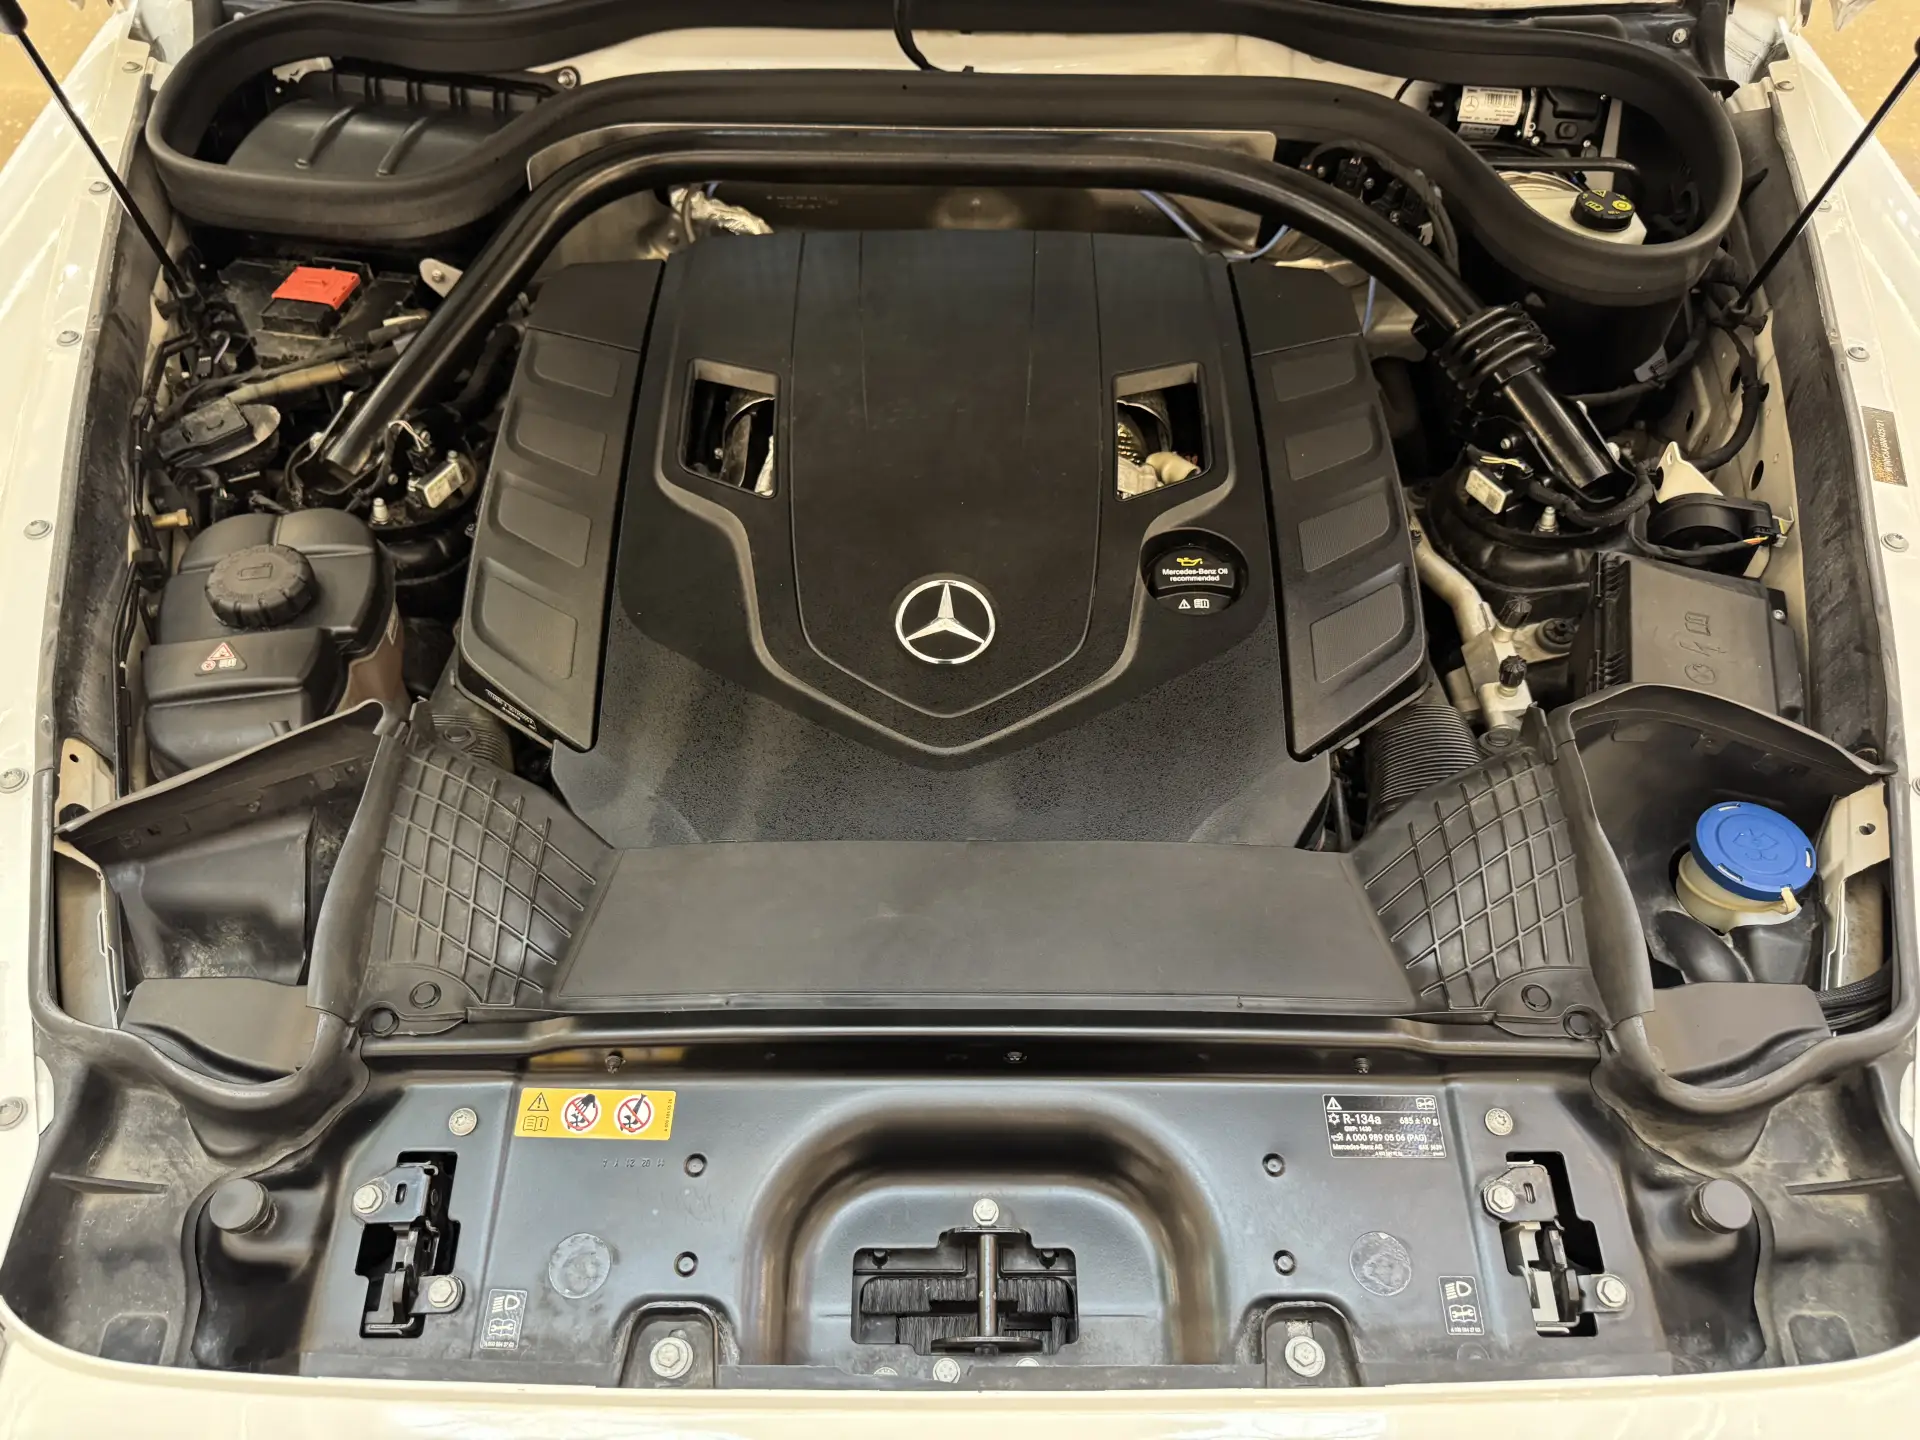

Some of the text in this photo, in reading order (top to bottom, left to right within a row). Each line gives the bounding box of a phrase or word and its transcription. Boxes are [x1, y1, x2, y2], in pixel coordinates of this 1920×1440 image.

[1217, 567, 1228, 575] Oil
[1342, 1113, 1382, 1125] R-134a
[1345, 1133, 1352, 1141] A
[1352, 1133, 1368, 1141] 000
[1368, 1133, 1383, 1141] 989
[1406, 1133, 1427, 1143] (PAG)
